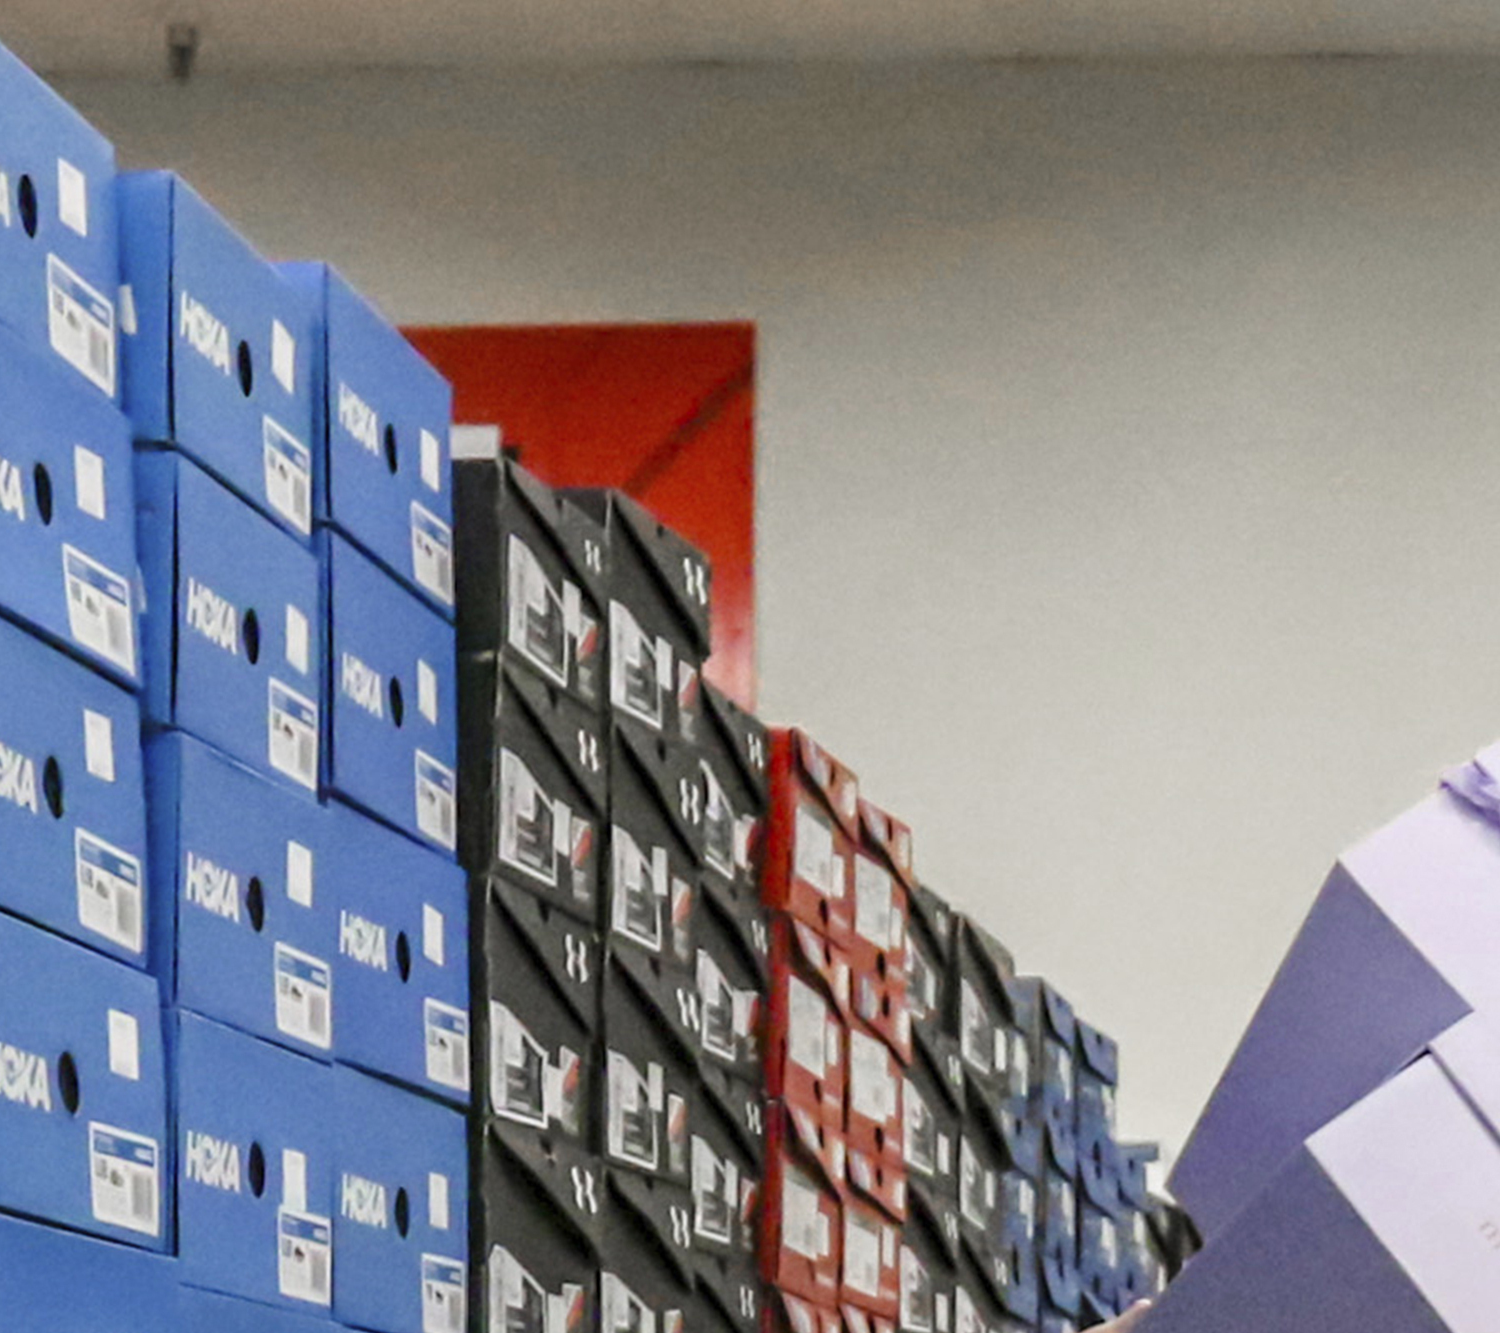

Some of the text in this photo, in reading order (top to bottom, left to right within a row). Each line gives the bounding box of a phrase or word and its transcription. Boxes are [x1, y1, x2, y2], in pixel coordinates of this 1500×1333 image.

[180, 291, 230, 375] HOKA
[339, 383, 379, 455] HOKA
[187, 578, 237, 654] HOKA
[342, 653, 382, 718] HOKA
[186, 852, 239, 922] HOKA
[340, 910, 387, 971] HOKA
[186, 1131, 240, 1192] HOKA
[342, 1174, 387, 1228] HOKA
